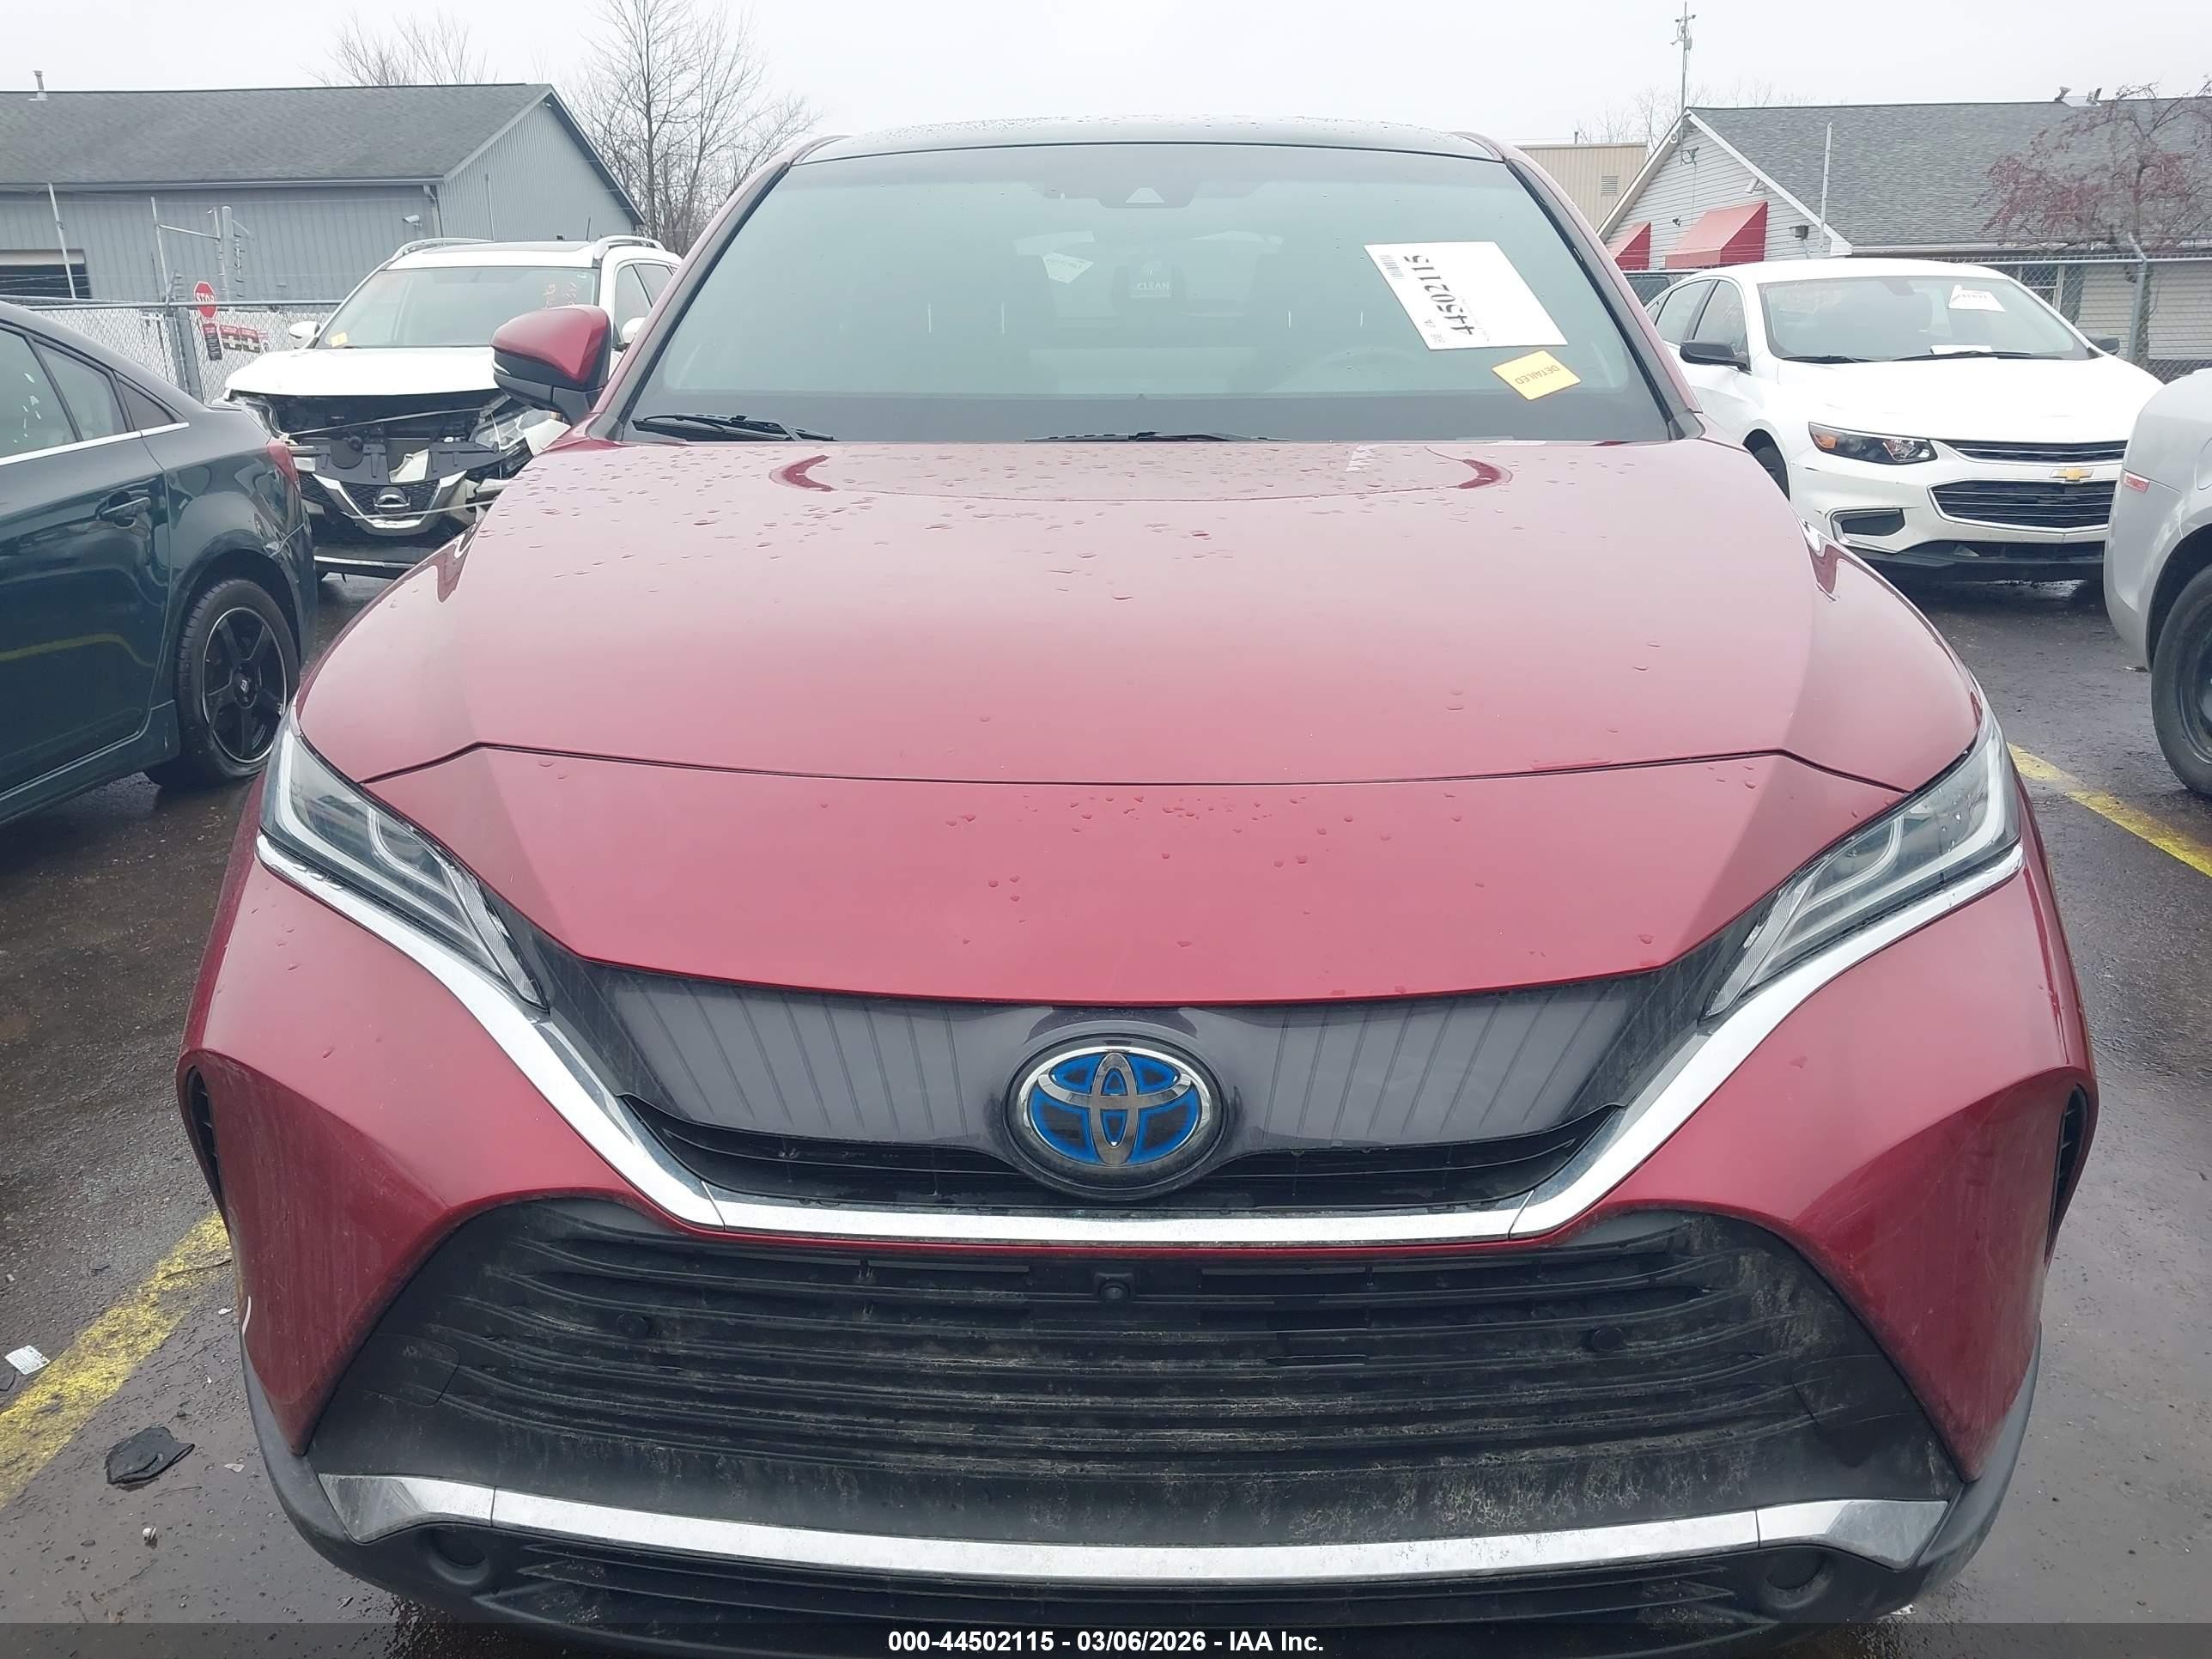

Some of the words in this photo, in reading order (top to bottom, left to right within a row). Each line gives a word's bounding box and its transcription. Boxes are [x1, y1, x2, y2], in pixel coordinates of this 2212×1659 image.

[196, 292, 215, 307] STOP
[1403, 255, 1474, 335] 44502115
[1515, 365, 1560, 385] DETAILED
